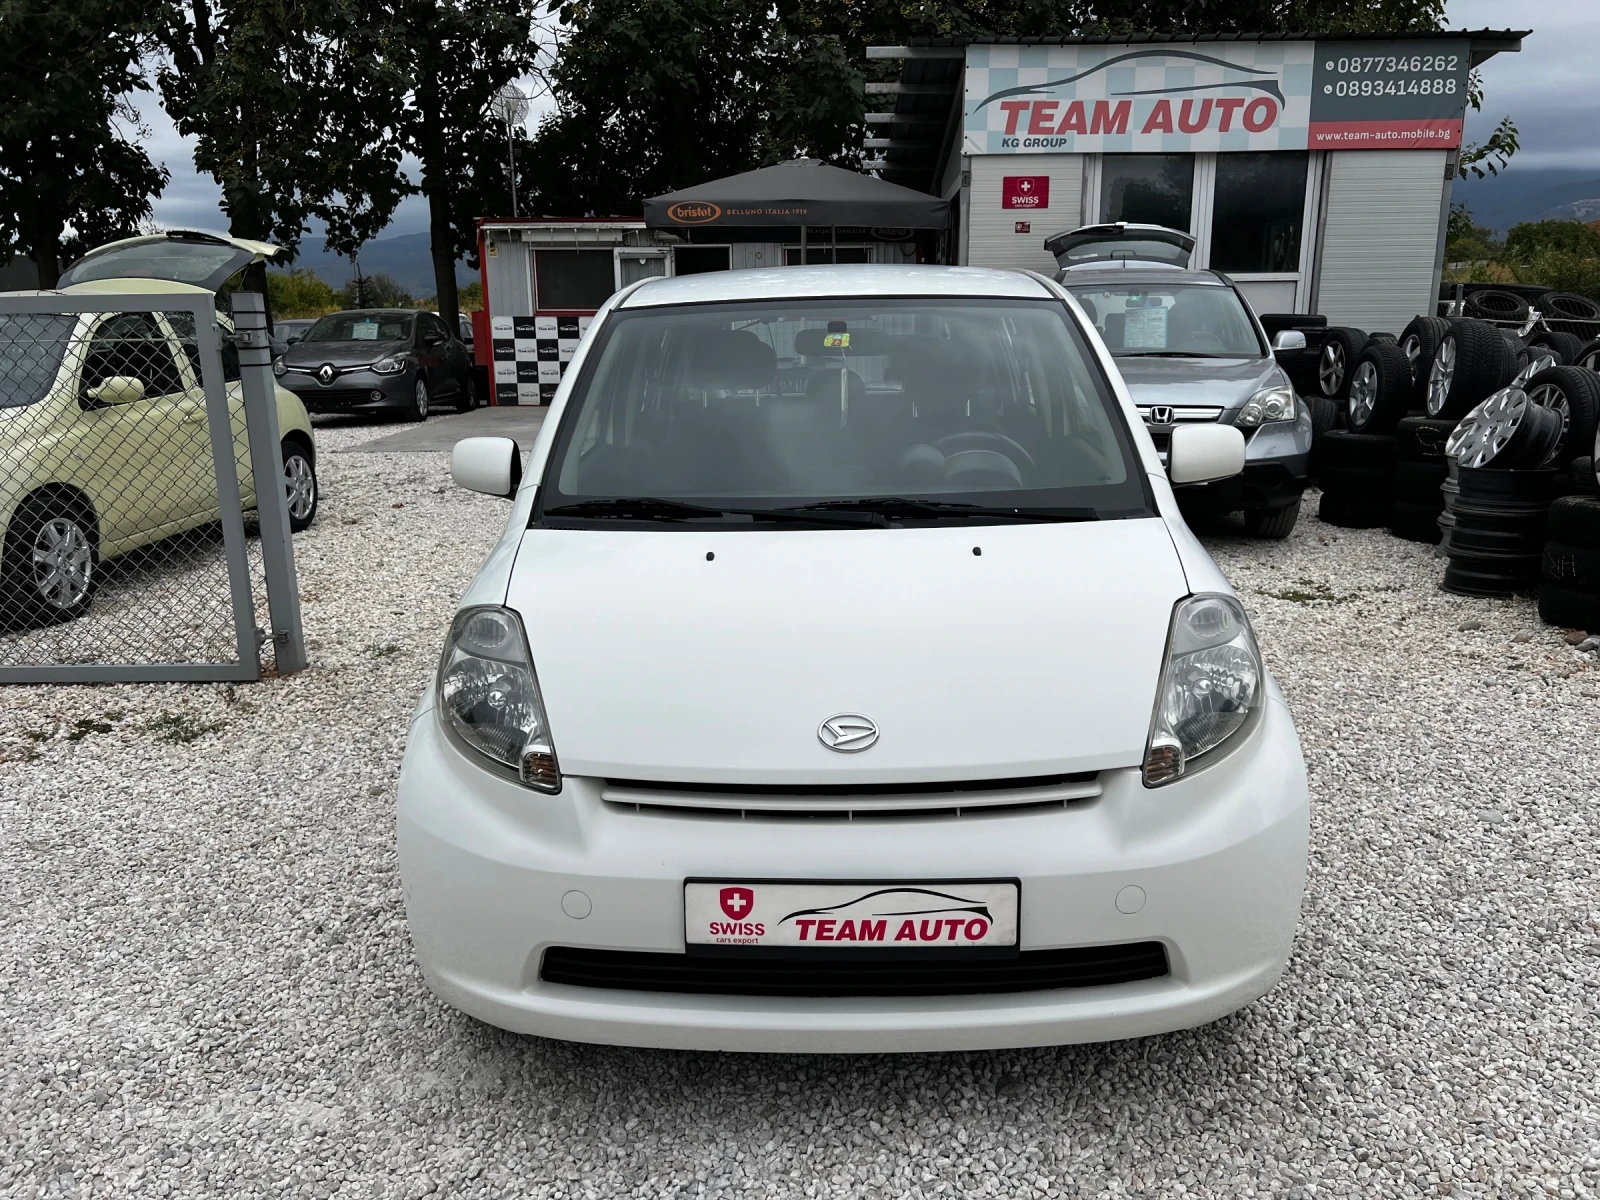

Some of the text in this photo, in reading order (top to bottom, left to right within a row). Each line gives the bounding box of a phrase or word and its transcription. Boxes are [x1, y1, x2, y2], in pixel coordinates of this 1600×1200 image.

[1337, 55, 1458, 73] 0877346262
[1335, 79, 1457, 97] 0893414888
[1000, 97, 1279, 136] TEAM AUTO
[1316, 129, 1451, 141] www.team-auto.mobile.bg
[1001, 138, 1067, 148] KG GROUP
[1011, 196, 1039, 204] SWISS
[677, 206, 712, 217] bristot
[710, 922, 765, 936] SWISS
[796, 918, 988, 941] TEAM AUTO
[733, 937, 759, 945] export
